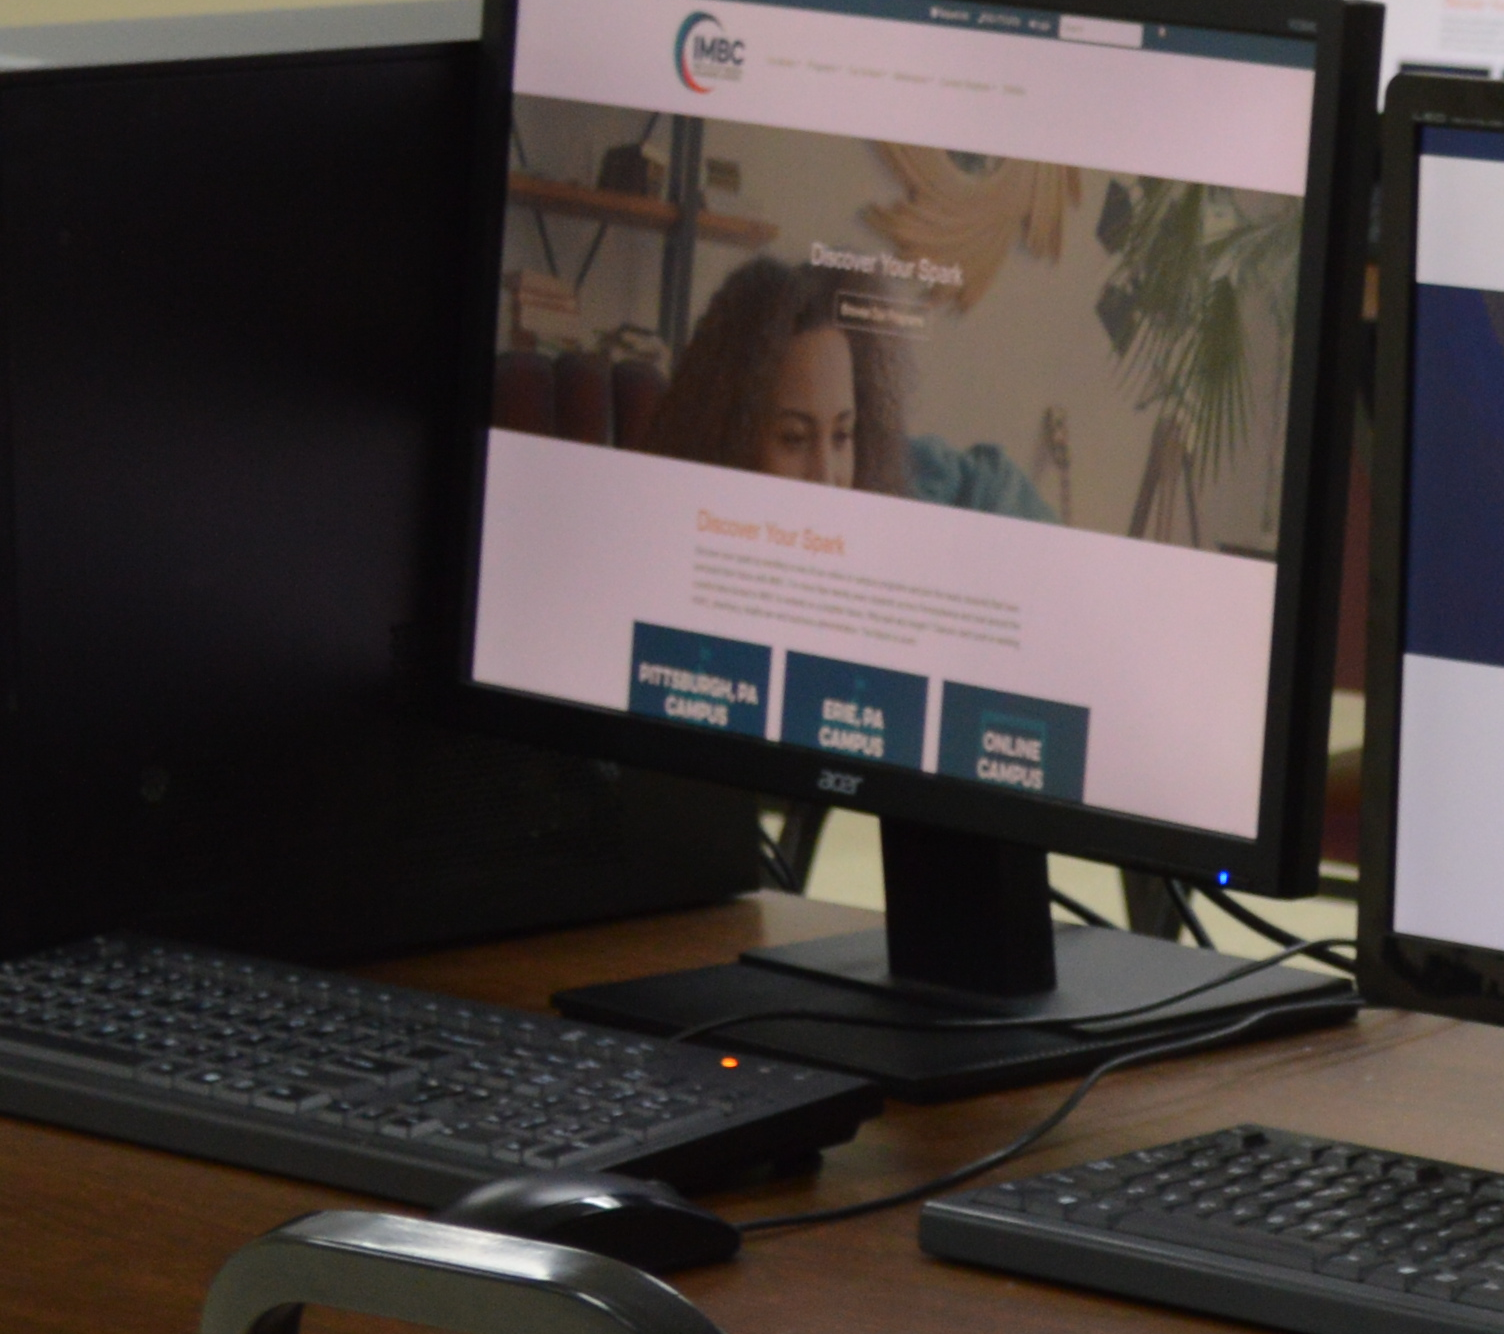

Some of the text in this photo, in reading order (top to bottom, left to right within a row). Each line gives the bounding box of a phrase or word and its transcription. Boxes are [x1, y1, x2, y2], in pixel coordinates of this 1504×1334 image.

[692, 33, 746, 67] IMBC
[810, 240, 964, 288] Discover Your Spark
[696, 507, 846, 555] Discover Your Spark
[638, 661, 759, 706] PITTSBURGH, PA
[663, 695, 729, 727] CAMPUS
[861, 705, 885, 730] PA
[818, 726, 885, 759] CAMPUS
[980, 729, 1043, 762] ONLINE
[816, 769, 864, 795] acer
[975, 757, 1044, 790] CAMPUS
